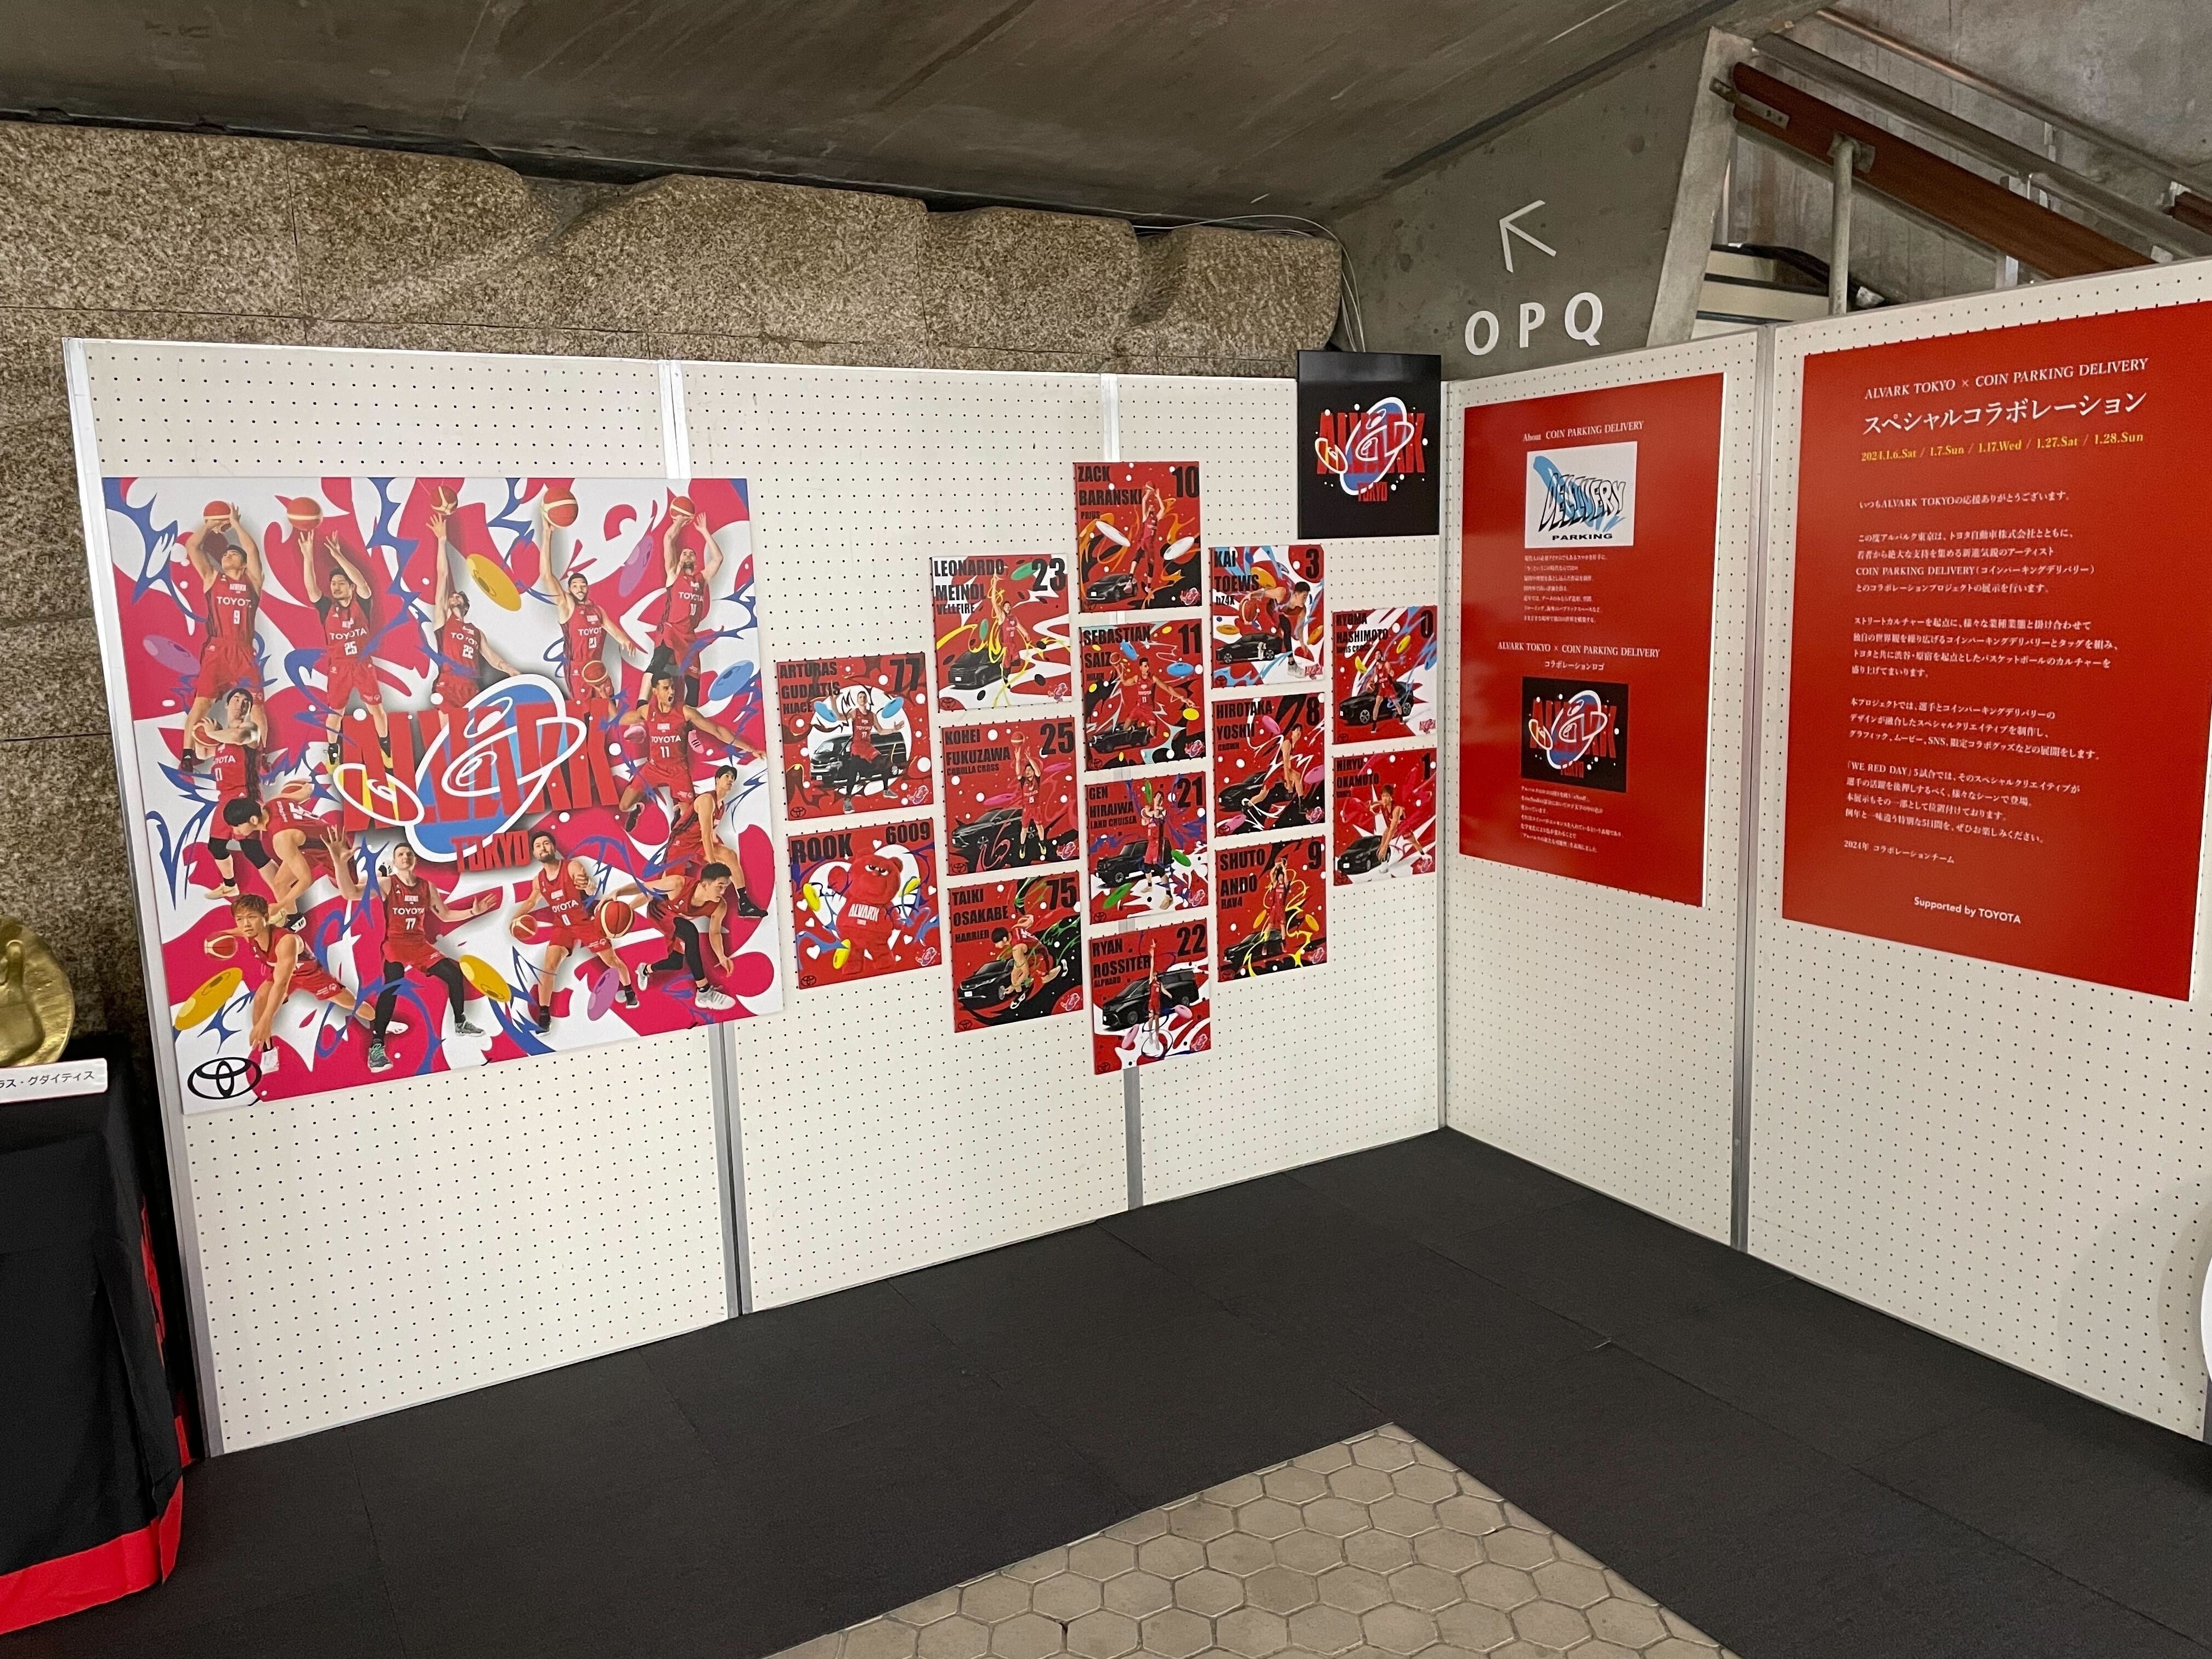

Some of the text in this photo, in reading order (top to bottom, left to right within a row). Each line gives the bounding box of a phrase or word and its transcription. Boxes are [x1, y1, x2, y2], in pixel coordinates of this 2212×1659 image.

[1464, 292, 1603, 356] O P Q
[1865, 385, 1910, 400] ALVARK
[1913, 379, 1956, 394] TOKYO
[1975, 373, 2008, 387] COIN
[2013, 366, 2074, 383] PARKING
[2079, 358, 2149, 376] DELIVERY
[1863, 392, 2147, 436] スペシャルコラボレーション
[1545, 429, 1565, 439] COIN
[1567, 425, 1602, 437] PARKING
[1605, 420, 1644, 433] DELIVERY
[1078, 466, 1110, 482] ZACK
[1171, 466, 1200, 498] 10
[1079, 489, 1143, 506] BARANSKI
[1538, 472, 1626, 532] DELIVERY
[934, 558, 1005, 577] LEONARDO
[1214, 550, 1235, 568] KAI
[1305, 549, 1319, 579] 3
[1031, 558, 1066, 591] 23
[1855, 567, 1879, 575] COIN
[1882, 566, 1924, 575] PARKING
[935, 584, 986, 601] MEINDL
[1214, 574, 1259, 592] TOEWS
[217, 596, 252, 608] TOYOT
[234, 610, 240, 624] 9
[1420, 610, 1434, 638] 0
[329, 628, 367, 640] TOYOTA
[1083, 627, 1151, 646] SEBASTIAN
[1178, 624, 1202, 654] 11
[1336, 628, 1389, 644] HASHIMOTO
[344, 641, 358, 656] 25
[462, 644, 474, 659] 22
[1498, 641, 1525, 651] ALVARK
[1526, 642, 1551, 652] TOKYO
[1561, 645, 1581, 653] COIN
[1583, 645, 1618, 656] PARKING
[1621, 647, 1660, 658] DELIVERY
[1084, 652, 1112, 669] SAIZ
[1544, 660, 1605, 670] コラボレーションロゴ
[780, 662, 837, 679] ARTURAS
[890, 658, 921, 693] 77
[1216, 701, 1273, 719] HIROTAKA
[1306, 697, 1320, 726] 8
[650, 735, 681, 743] TOYOTA
[945, 729, 980, 745] KOHEI
[1040, 723, 1074, 755] 25
[660, 746, 670, 758] 11
[946, 747, 1011, 765] FUKUZAWA
[1421, 752, 1431, 780] 1
[1867, 764, 1886, 772] RED
[1089, 787, 1108, 800] GEN
[1177, 777, 1204, 809] 21
[1090, 802, 1134, 818] HIRAIWA
[886, 822, 930, 844] 6009
[452, 831, 530, 872] TOKYO
[791, 833, 853, 864] ROOK
[1308, 840, 1322, 870] 9
[1220, 849, 1266, 871] SHUTO
[1046, 877, 1077, 911] 75
[1220, 874, 1258, 897] ANDO
[952, 889, 984, 906] TAIKI
[953, 905, 1008, 927] OSAKABE
[1914, 896, 2021, 924] Supported by TOYOTA
[405, 918, 416, 930] 77
[1092, 938, 1122, 957] RYAN
[1176, 924, 1206, 957] 22
[1093, 955, 1152, 978] ROSSITER
